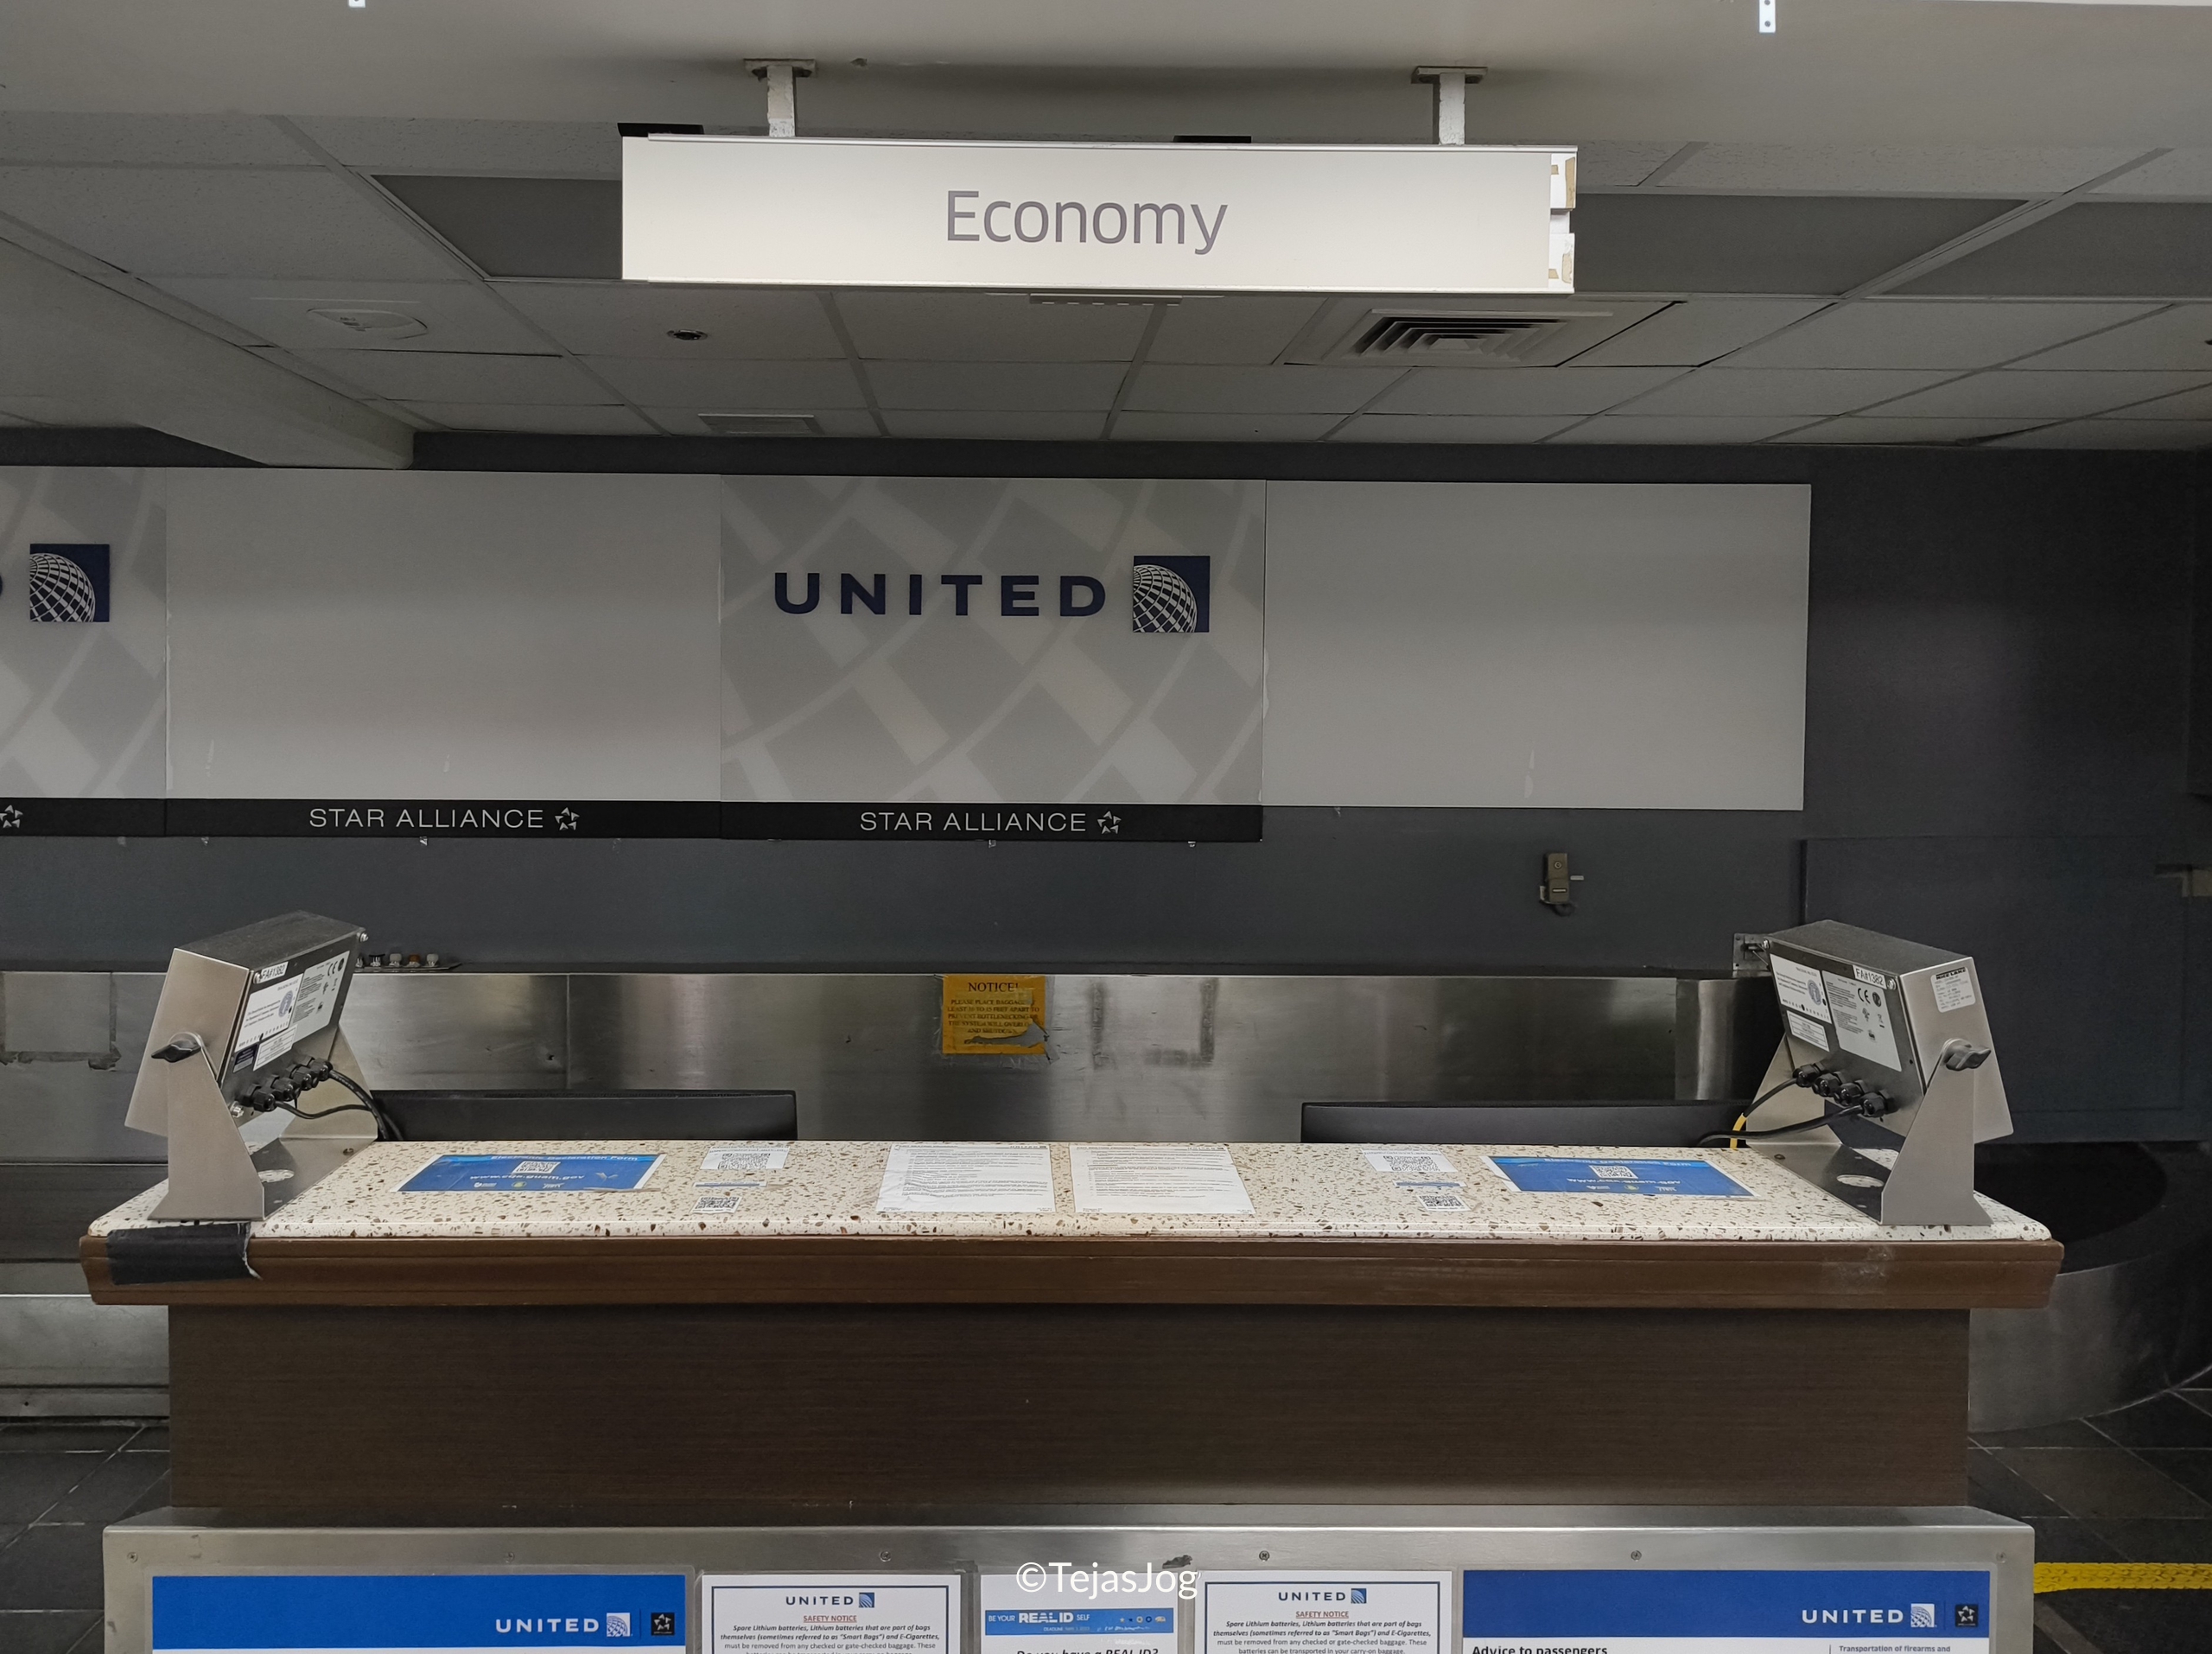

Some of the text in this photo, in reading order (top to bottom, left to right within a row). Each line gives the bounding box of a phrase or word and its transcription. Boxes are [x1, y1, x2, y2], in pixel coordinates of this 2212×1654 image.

[946, 189, 1228, 255] Economy
[773, 572, 1106, 617] UNITED
[308, 808, 544, 830] STAR ALLIANCE
[860, 811, 1087, 833] STAR ALLIANCE
[1855, 968, 1884, 986] FA#1382
[968, 982, 1019, 992] NOTICE!
[785, 1596, 854, 1606] UNITED
[1278, 1592, 1346, 1601] UNITED
[1019, 1613, 1058, 1623] REAL
[1059, 1612, 1074, 1623] ID
[1802, 1609, 1904, 1624] UNITED
[495, 1618, 600, 1633] UNITED
